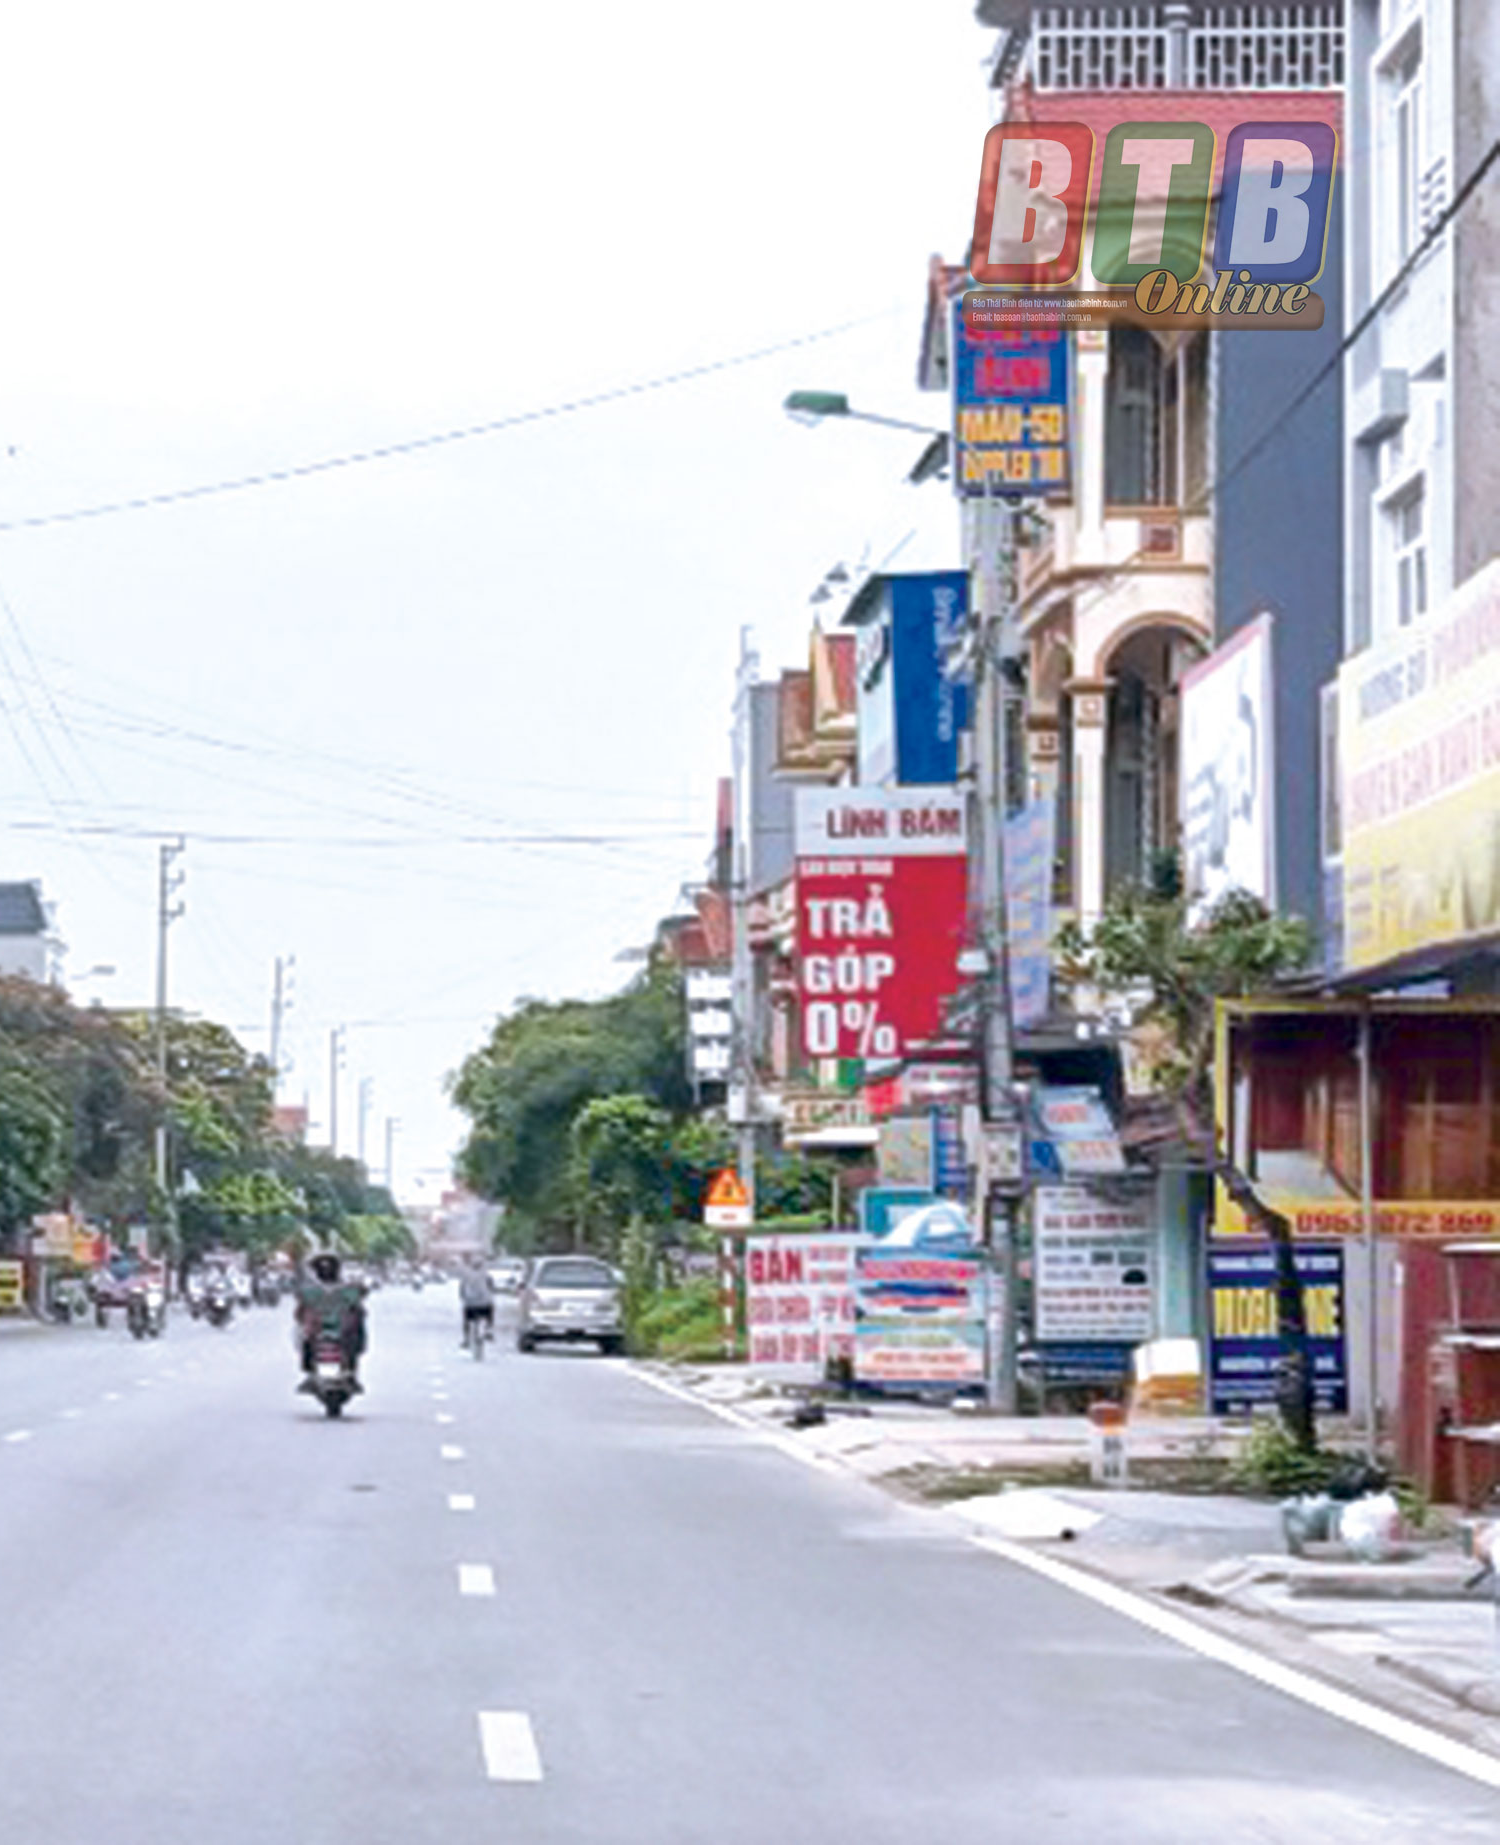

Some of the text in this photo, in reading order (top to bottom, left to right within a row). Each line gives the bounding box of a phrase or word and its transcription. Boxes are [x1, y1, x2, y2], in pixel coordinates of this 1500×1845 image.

[806, 883, 892, 938] TRẢ
[804, 944, 895, 994] GÓP
[806, 1002, 897, 1055] 0%
